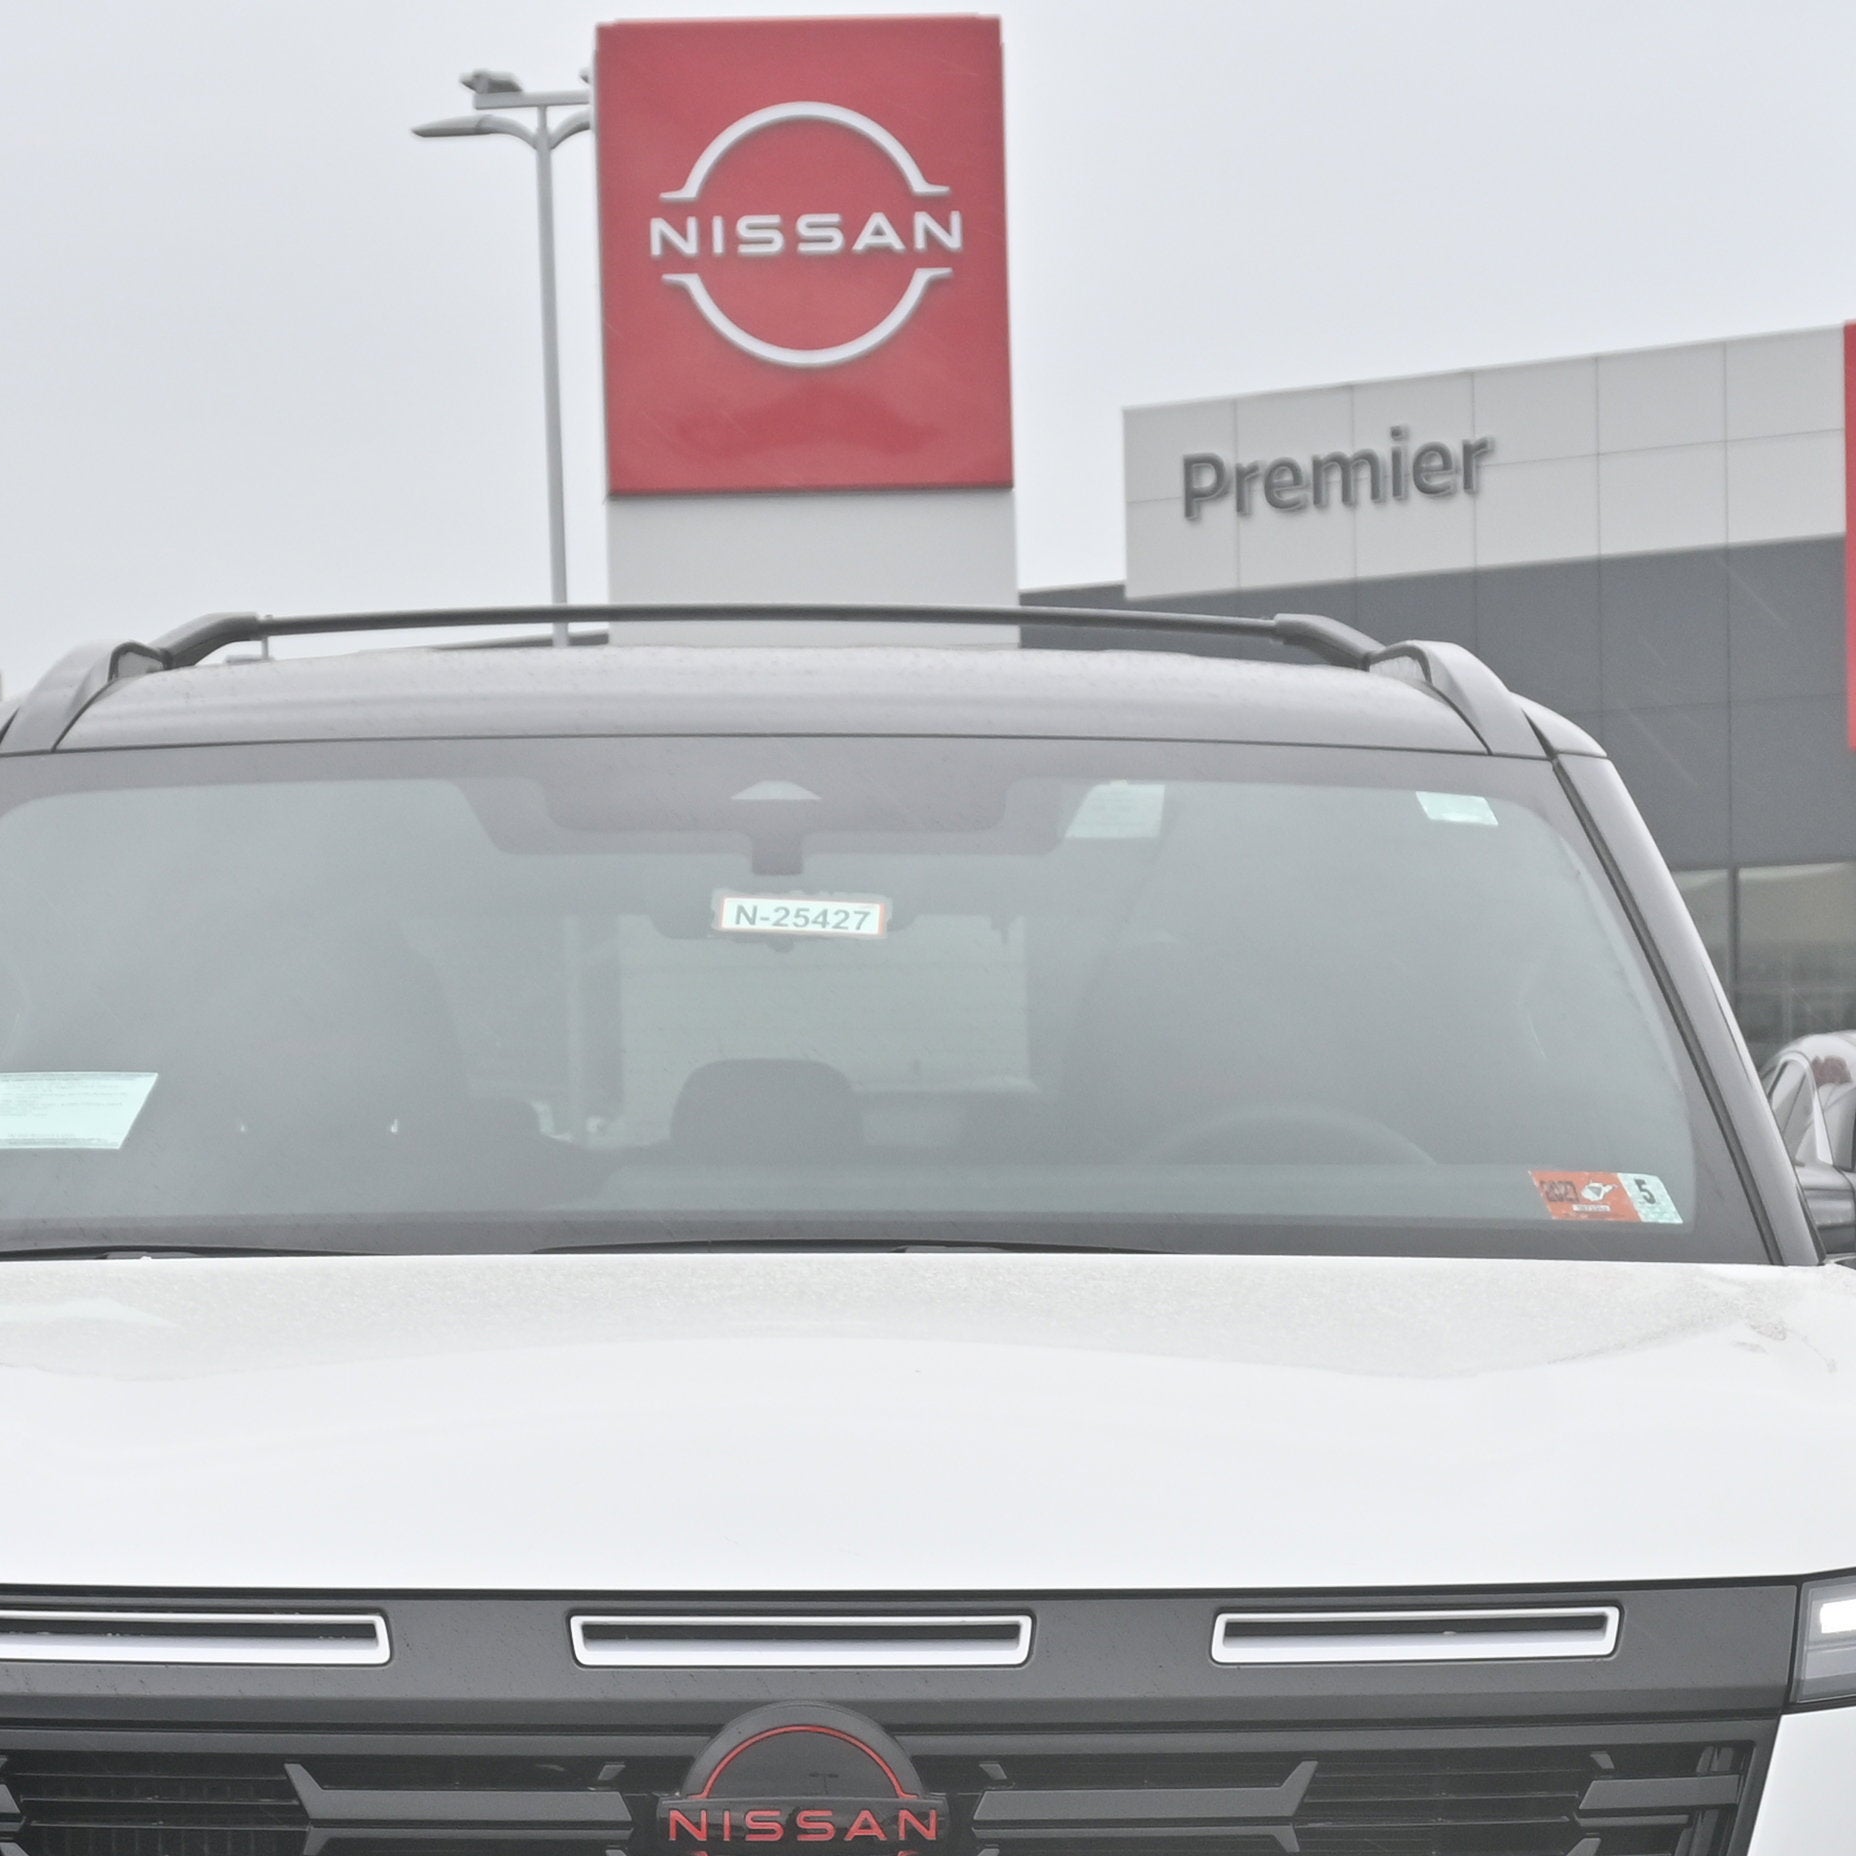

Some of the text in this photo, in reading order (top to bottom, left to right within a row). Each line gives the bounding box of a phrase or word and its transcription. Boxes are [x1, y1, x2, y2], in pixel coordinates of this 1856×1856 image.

[650, 210, 962, 258] NISSAN
[1182, 423, 1494, 520] Premier
[734, 902, 872, 932] N-25427
[1634, 1177, 1656, 1205] 5
[668, 1808, 940, 1843] NISSAN
